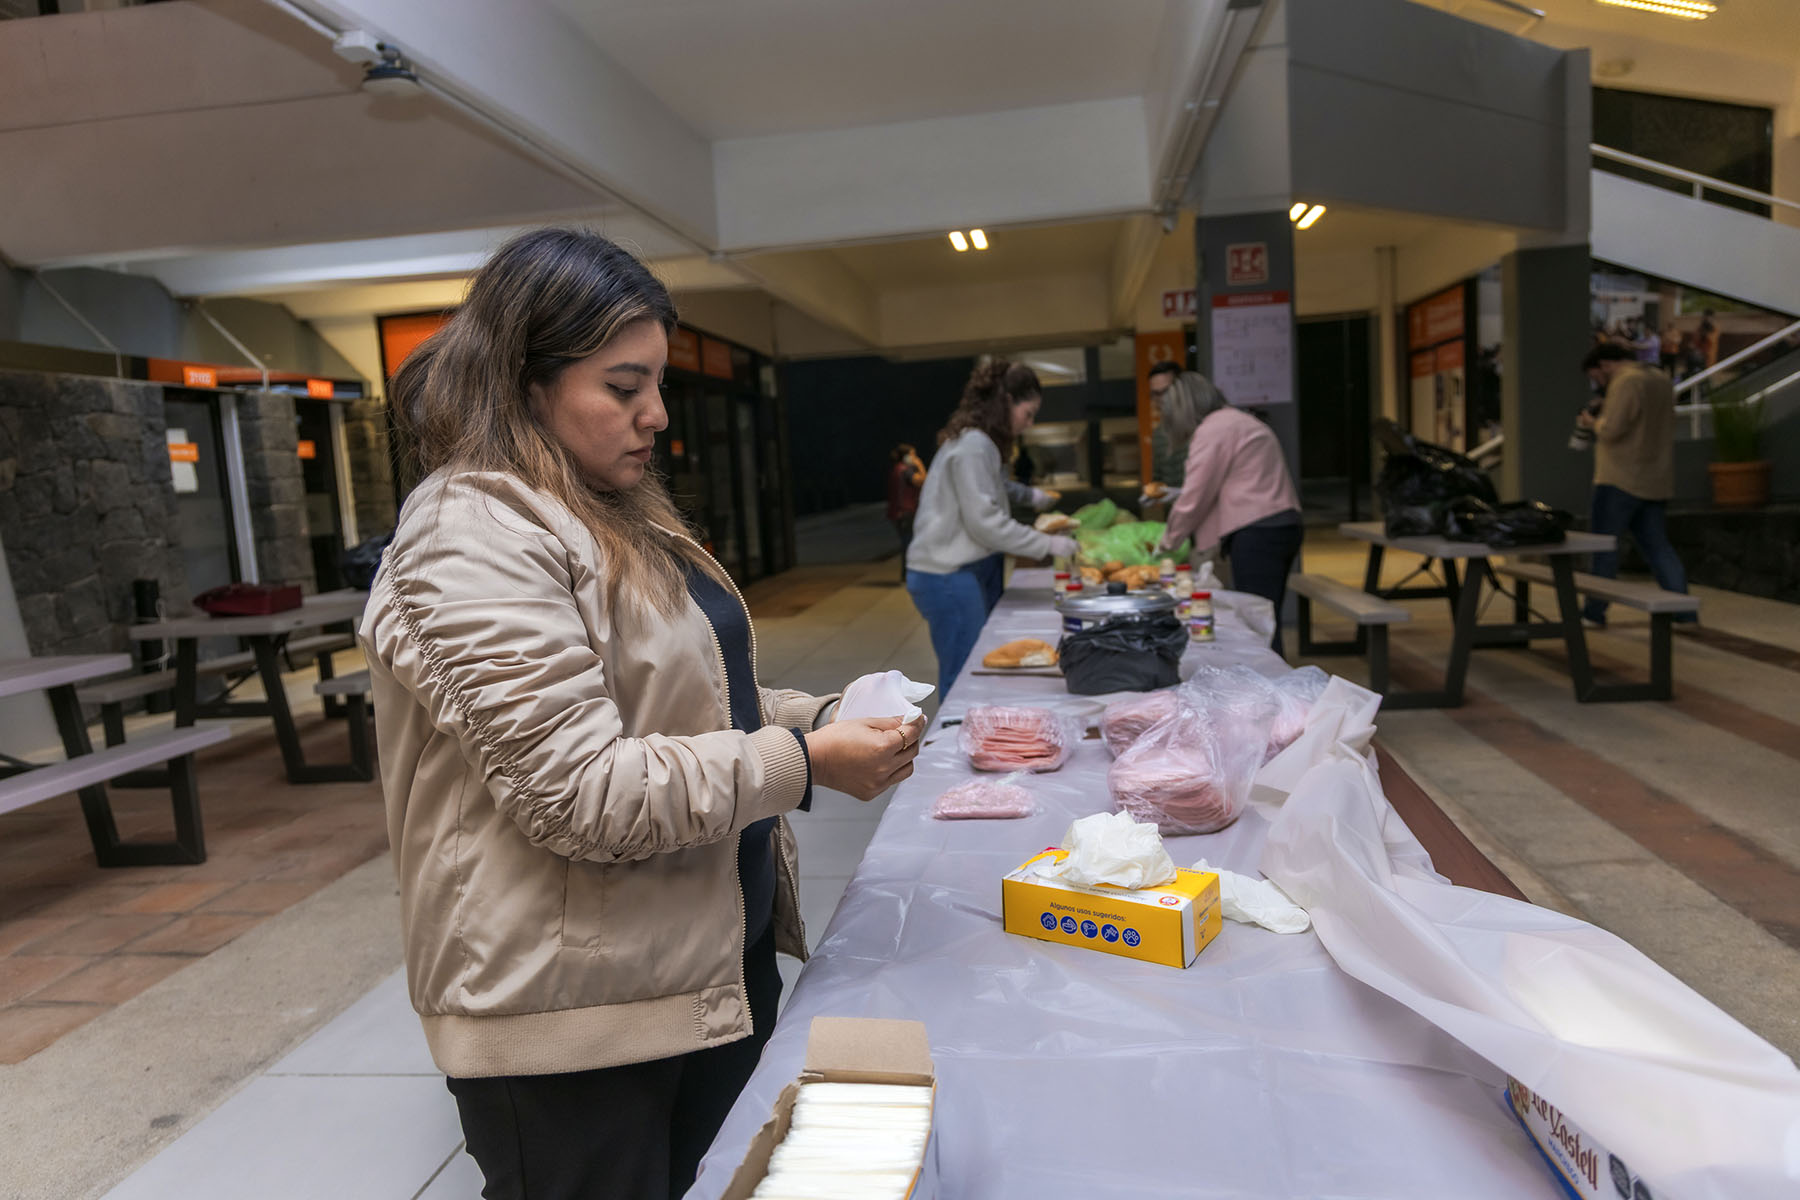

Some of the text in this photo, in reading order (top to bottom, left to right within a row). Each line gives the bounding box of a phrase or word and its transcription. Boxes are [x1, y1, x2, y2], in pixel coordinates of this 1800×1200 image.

[1049, 901, 1127, 922] Algunos usos sugeridos:
